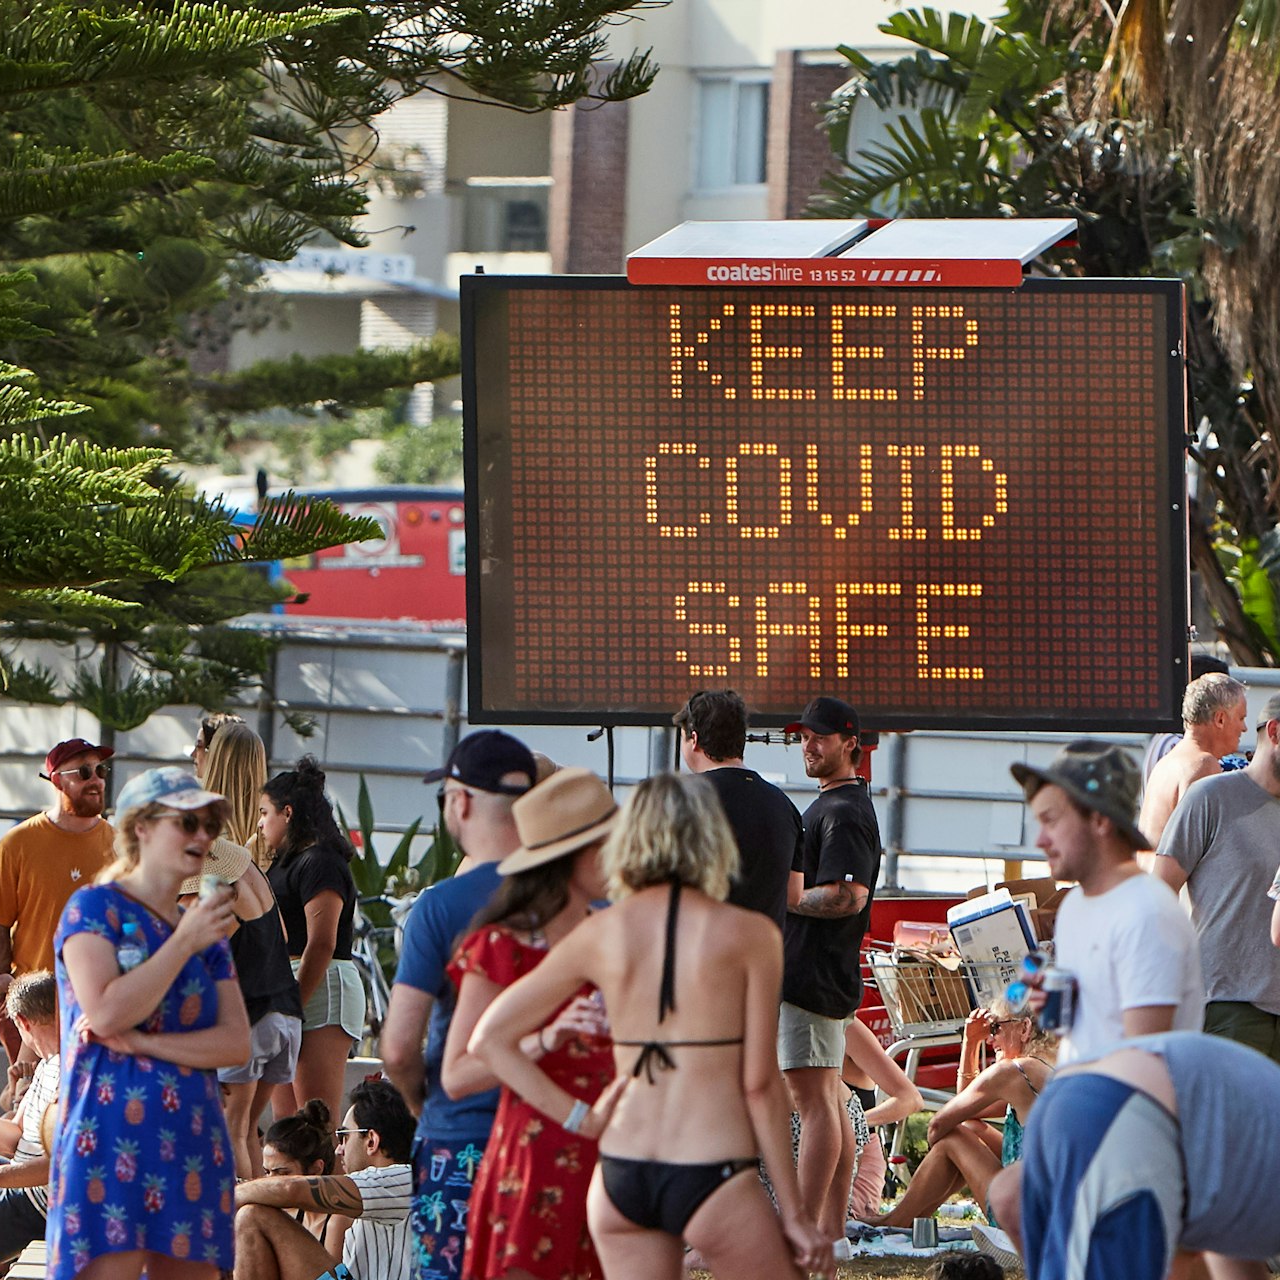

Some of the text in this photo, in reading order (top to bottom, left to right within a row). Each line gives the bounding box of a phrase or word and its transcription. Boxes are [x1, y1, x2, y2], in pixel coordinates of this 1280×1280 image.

[809, 269, 822, 281] 13
[825, 270, 838, 282] 15
[841, 270, 856, 282] 52
[668, 303, 980, 400] KEEP
[644, 442, 1008, 541] COVID
[675, 581, 984, 679] SAFE
